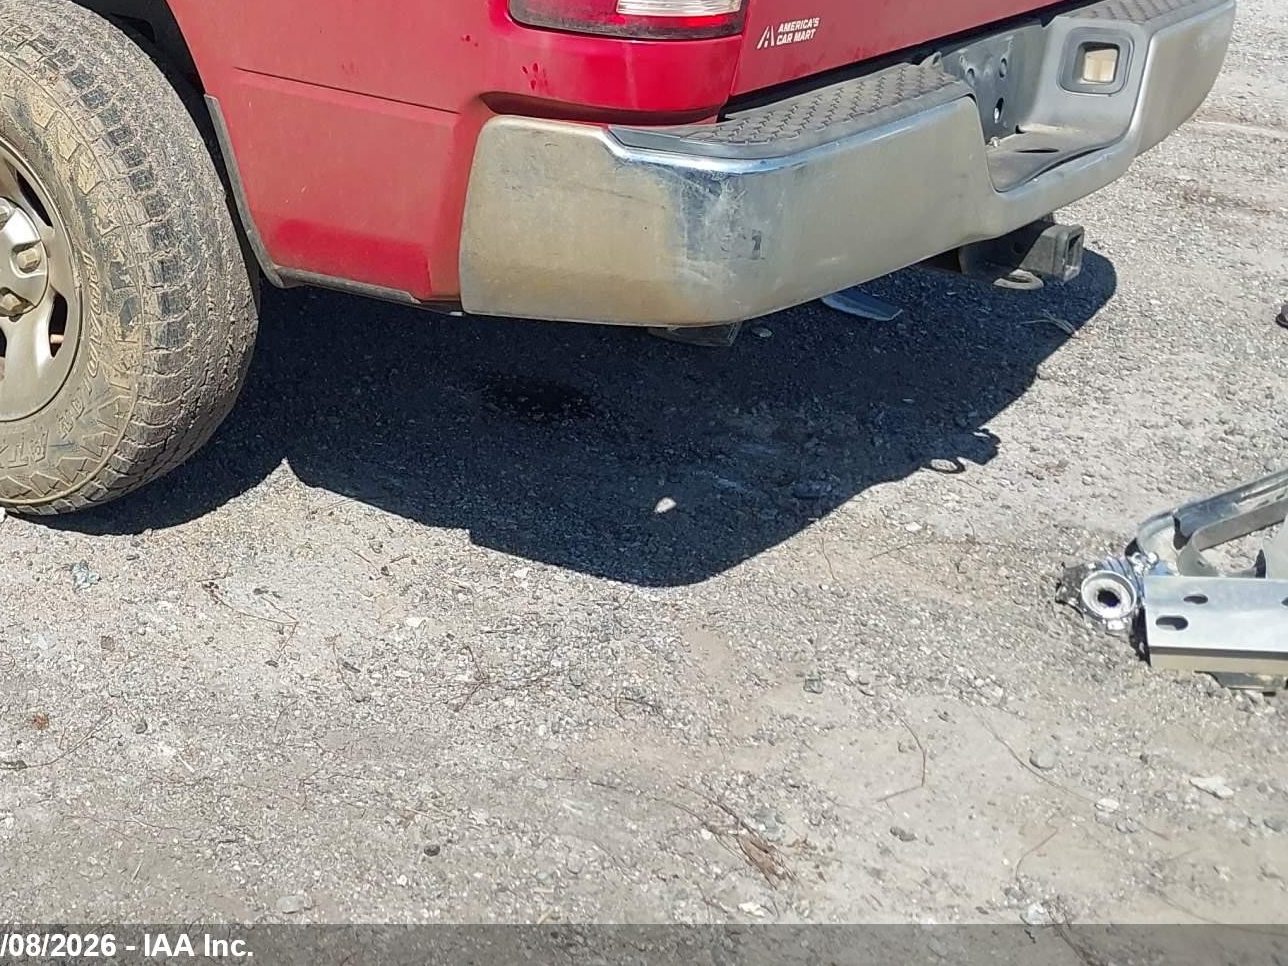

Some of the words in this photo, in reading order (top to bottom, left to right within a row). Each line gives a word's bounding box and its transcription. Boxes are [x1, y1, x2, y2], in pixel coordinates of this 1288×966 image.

[777, 17, 820, 33] AMERICA'S
[776, 32, 793, 46] CAR
[793, 28, 817, 42] MART
